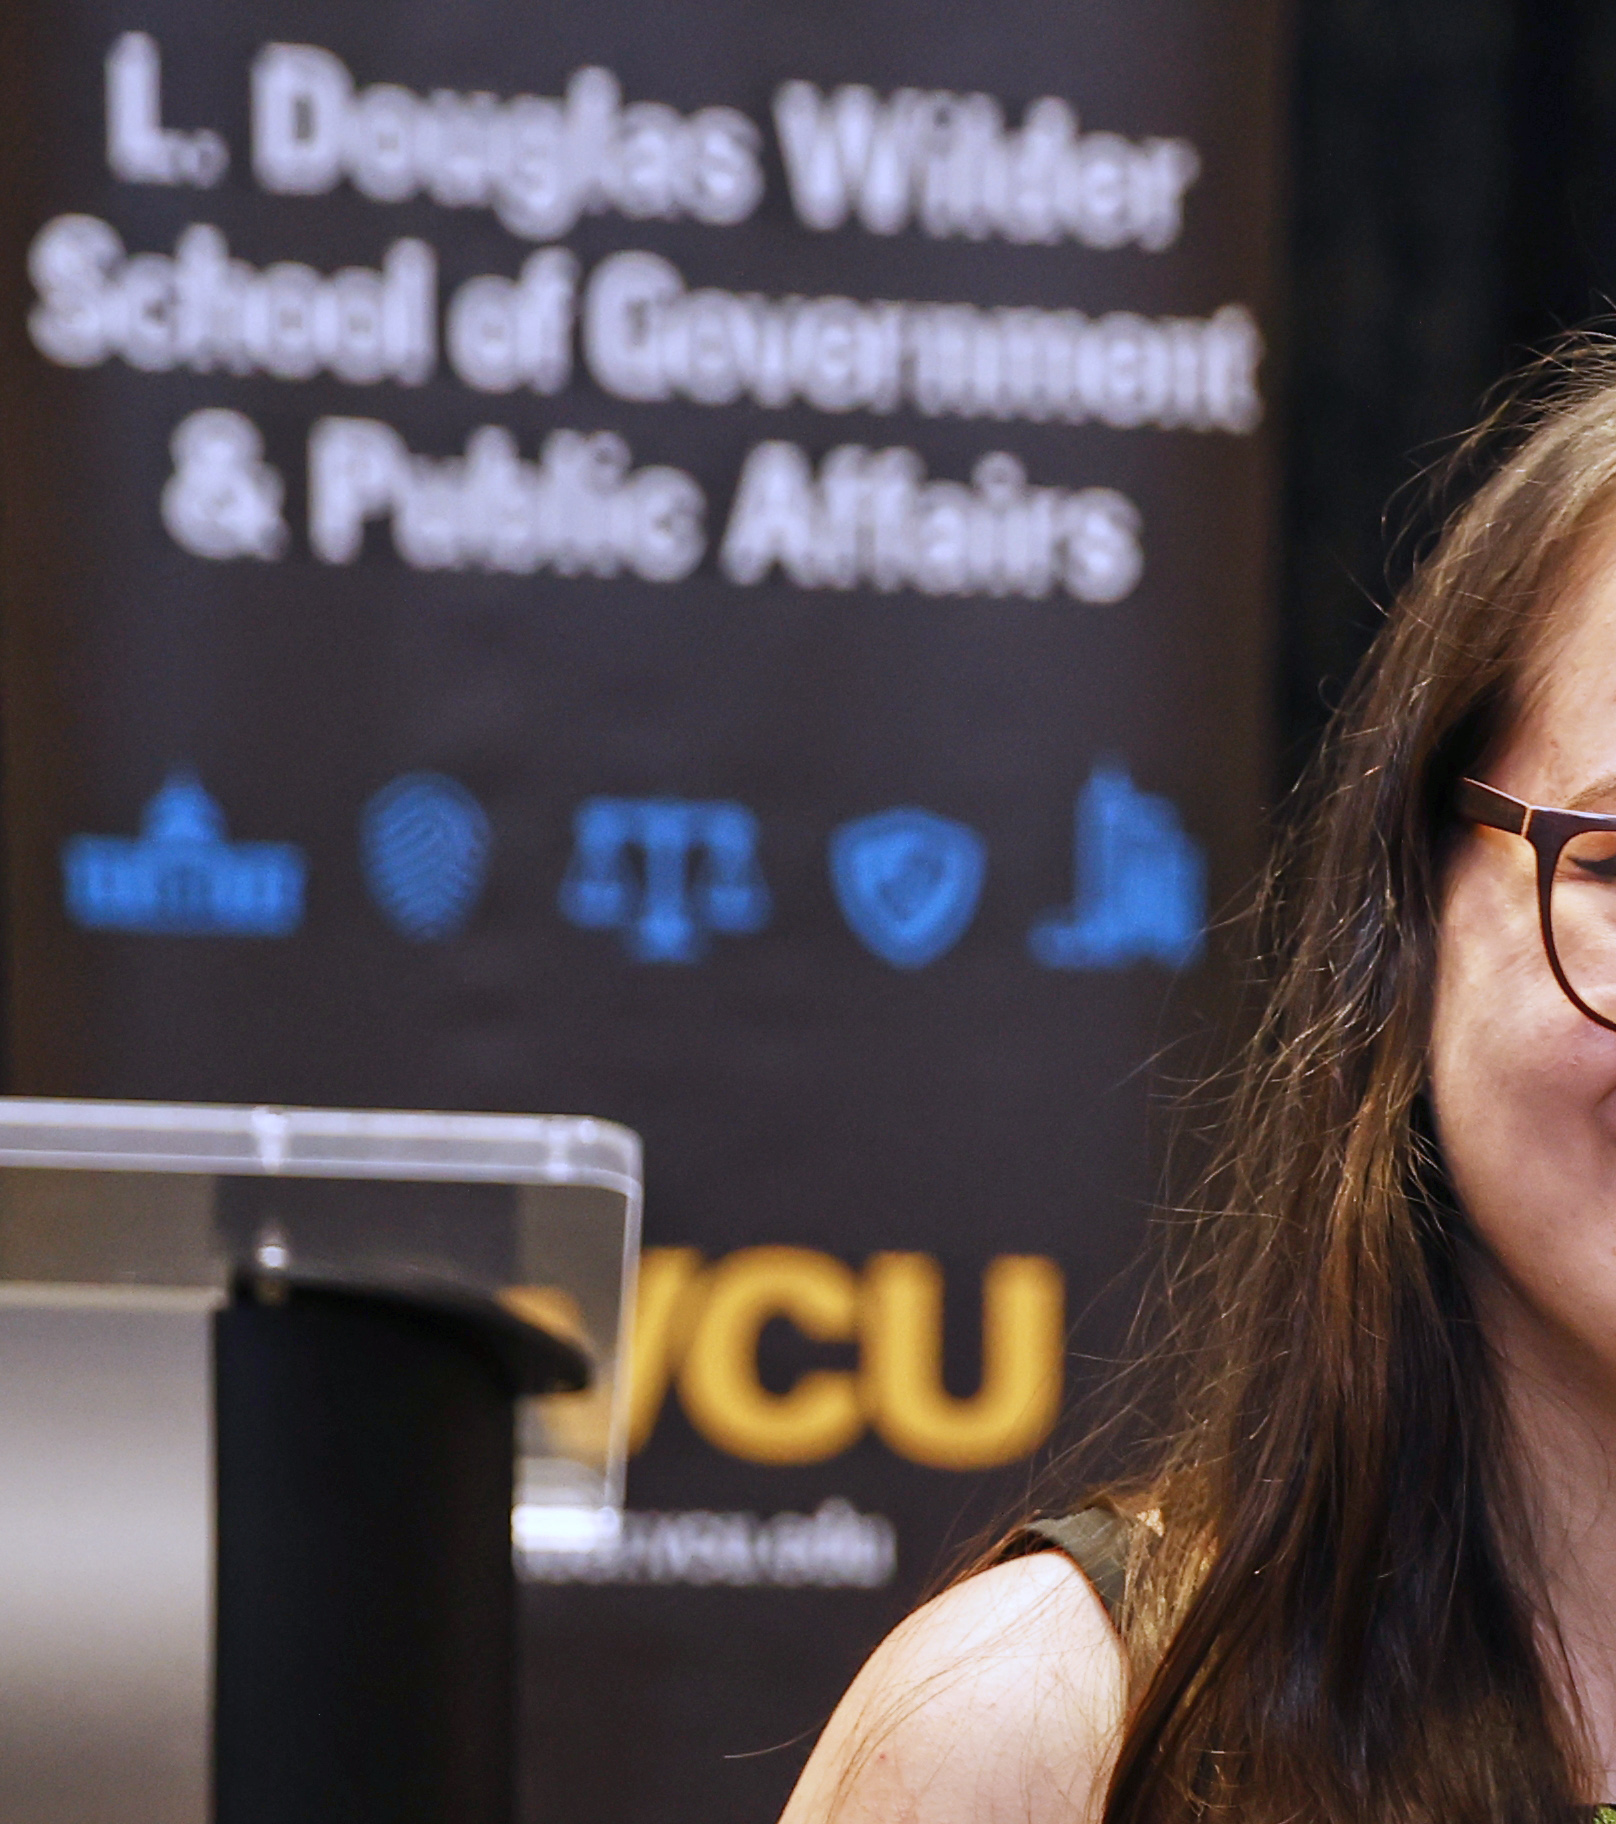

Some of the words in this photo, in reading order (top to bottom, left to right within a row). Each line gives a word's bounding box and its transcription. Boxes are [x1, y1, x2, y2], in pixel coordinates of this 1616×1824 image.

[105, 31, 227, 191] L.
[249, 40, 763, 239] Douglas
[775, 78, 1198, 252] Wilder
[28, 212, 435, 386] School
[447, 246, 577, 396] of
[585, 250, 1261, 433] Government
[163, 408, 286, 562] &
[308, 415, 706, 583] Public
[720, 441, 1143, 602] Affairs
